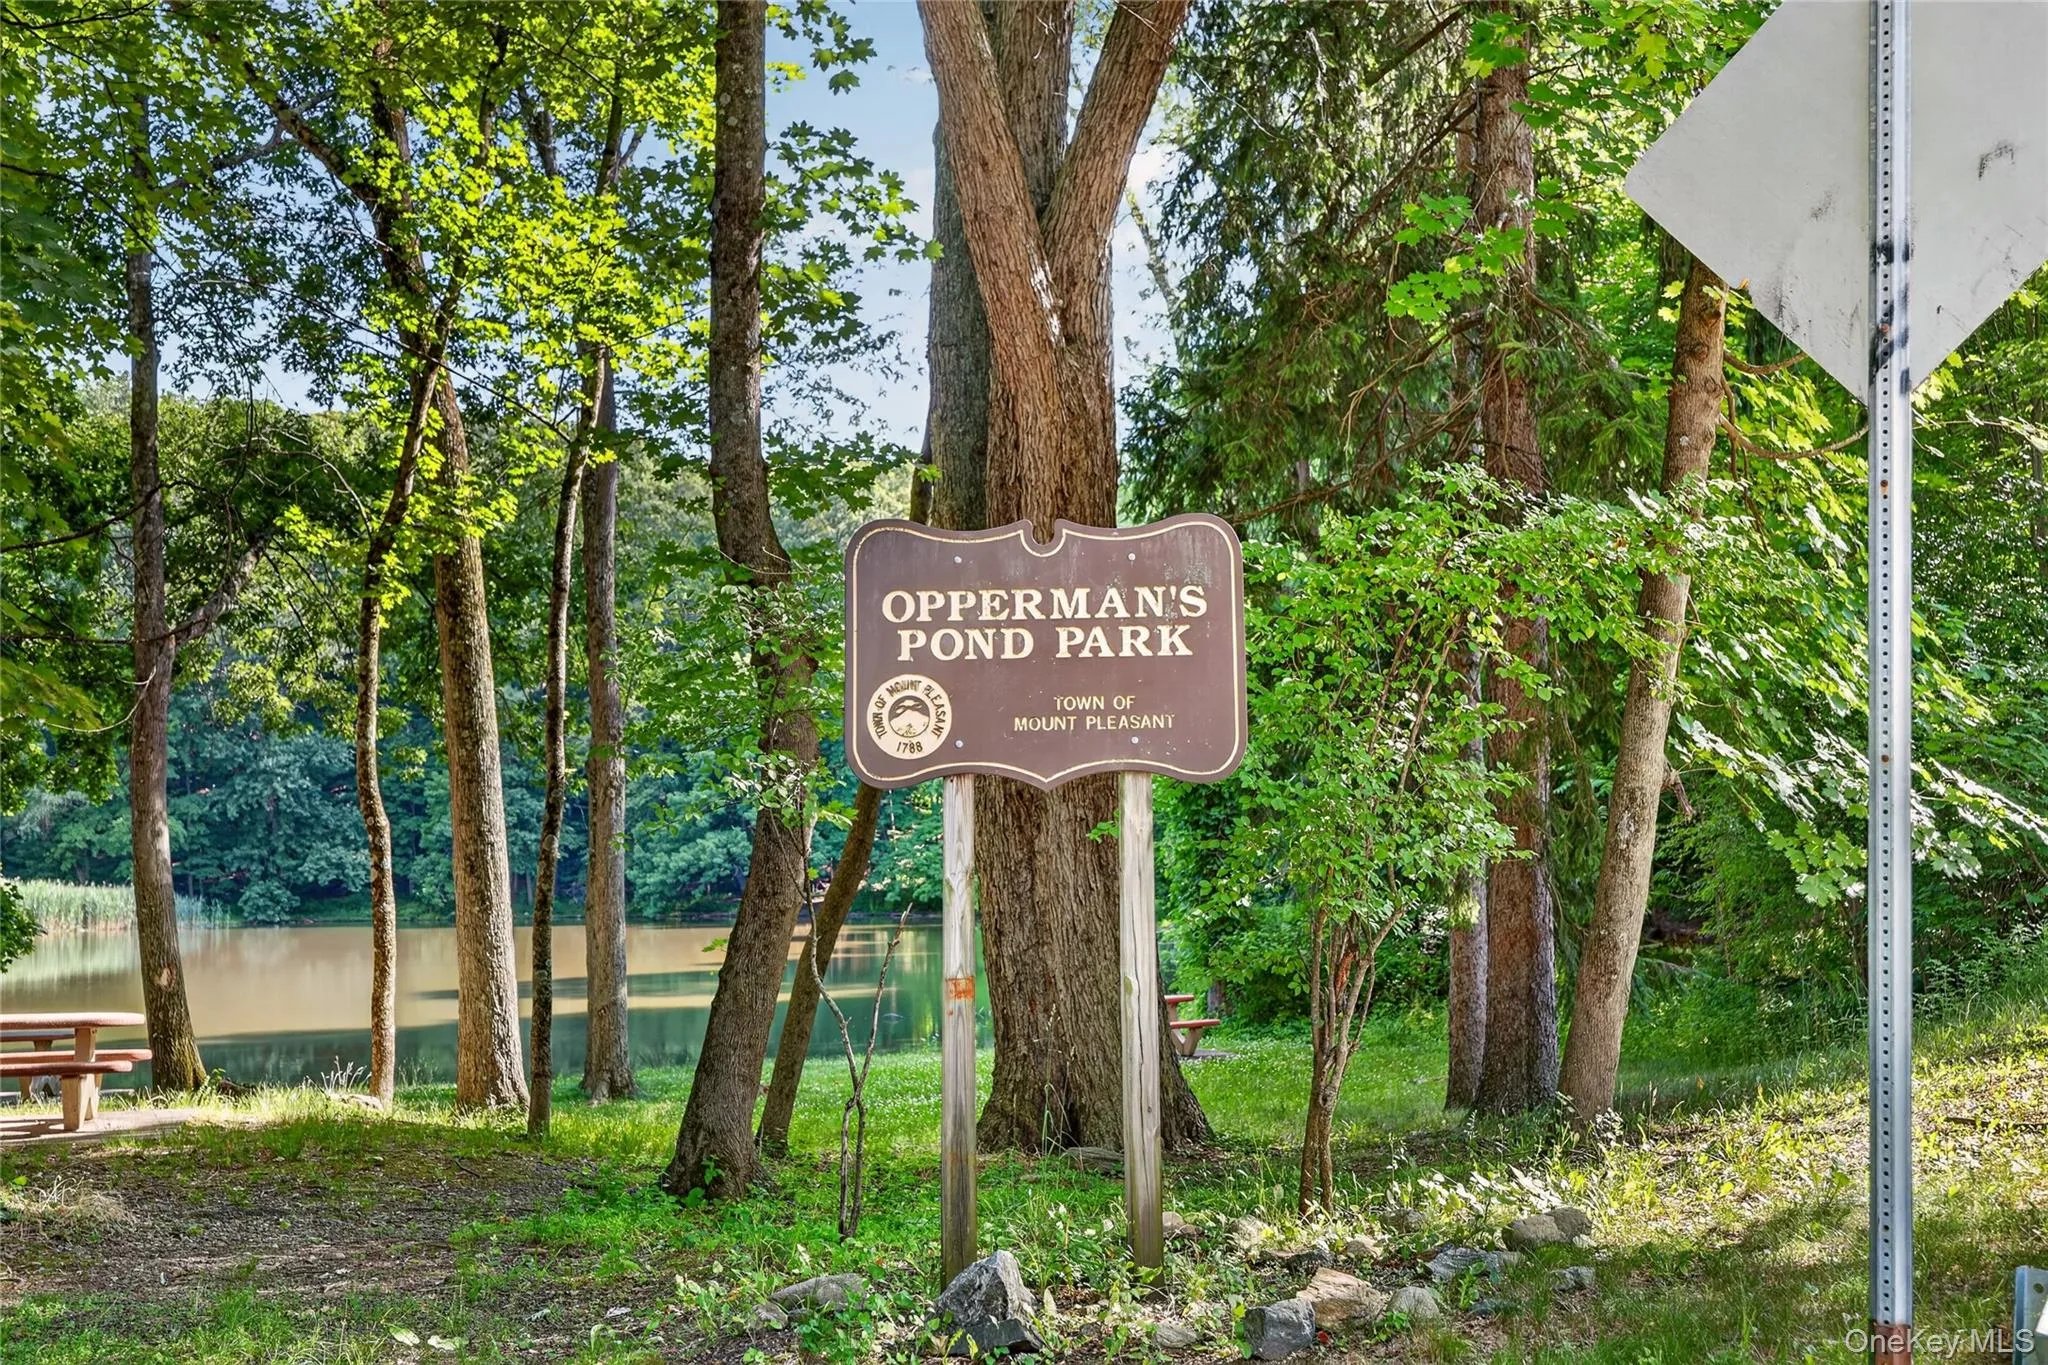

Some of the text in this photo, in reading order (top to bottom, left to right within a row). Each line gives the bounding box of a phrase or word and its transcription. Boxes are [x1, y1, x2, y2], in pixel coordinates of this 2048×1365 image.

[882, 585, 1207, 623] OPPERMAN'S
[897, 624, 1193, 661] POND PARK
[872, 679, 946, 740] TOWN OF MOUNT PLEASANT
[1054, 695, 1136, 711] TOWN OF
[1014, 714, 1175, 732] MOUNT PLEASANT
[896, 741, 923, 754] 1788
